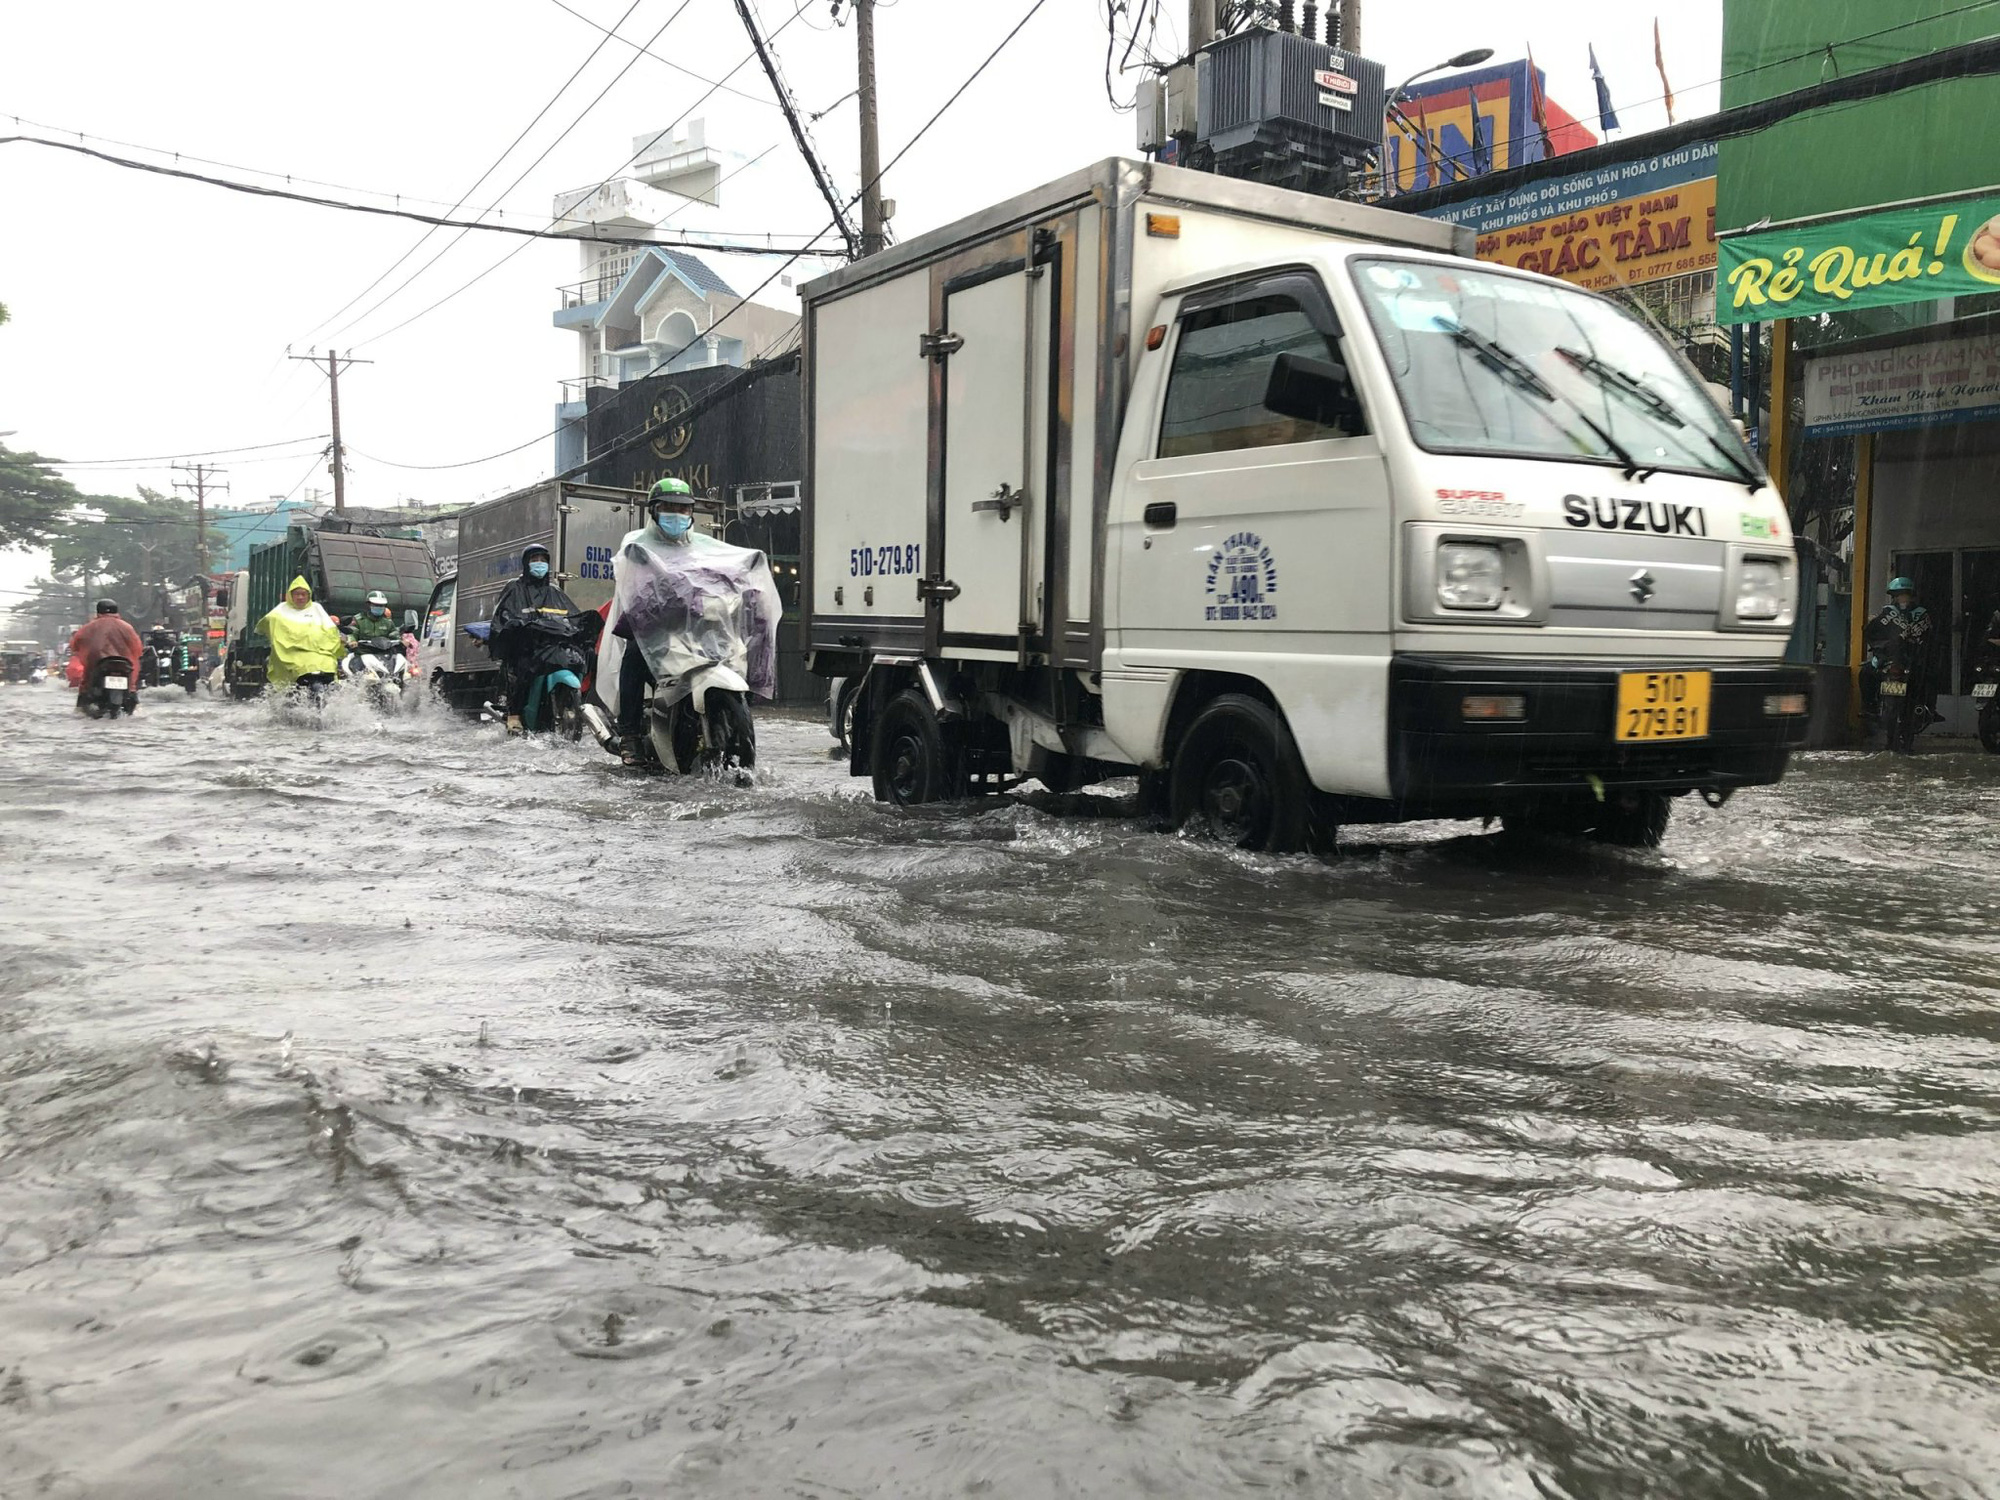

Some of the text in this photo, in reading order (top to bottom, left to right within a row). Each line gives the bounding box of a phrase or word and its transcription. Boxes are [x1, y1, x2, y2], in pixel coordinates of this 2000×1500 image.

[1462, 202, 1482, 220] KẾT
[1508, 192, 1538, 209] DỰNG
[1540, 184, 1560, 200] ĐỜI
[1562, 175, 1593, 195] SỐNG
[1597, 169, 1619, 185] VĂN
[1622, 161, 1647, 179] HÓA
[1650, 156, 1659, 172] Ở
[1662, 149, 1689, 169] KHU
[1692, 142, 1718, 161] DÂN
[1481, 186, 1618, 232] KHU PHỐ 8 VÀ KHU PHỐ 9
[1506, 226, 1546, 248] PHẬT
[1551, 213, 1589, 238] GIÁO
[1595, 205, 1633, 228] VIỆT
[1639, 195, 1679, 217] NAM
[1517, 235, 1601, 277] GIÁC
[1609, 217, 1691, 262] TÂM
[1647, 261, 1673, 276] 0777
[1676, 256, 1695, 270] 686
[1698, 252, 1717, 266] 555
[1727, 214, 1959, 308] Rẻ Quá!
[1436, 489, 1504, 500] SUPER
[1562, 494, 1707, 537] SUZUKI
[850, 543, 920, 577] 51D-279.81
[1645, 674, 1688, 703] 51D
[1625, 706, 1699, 737] 279.81
